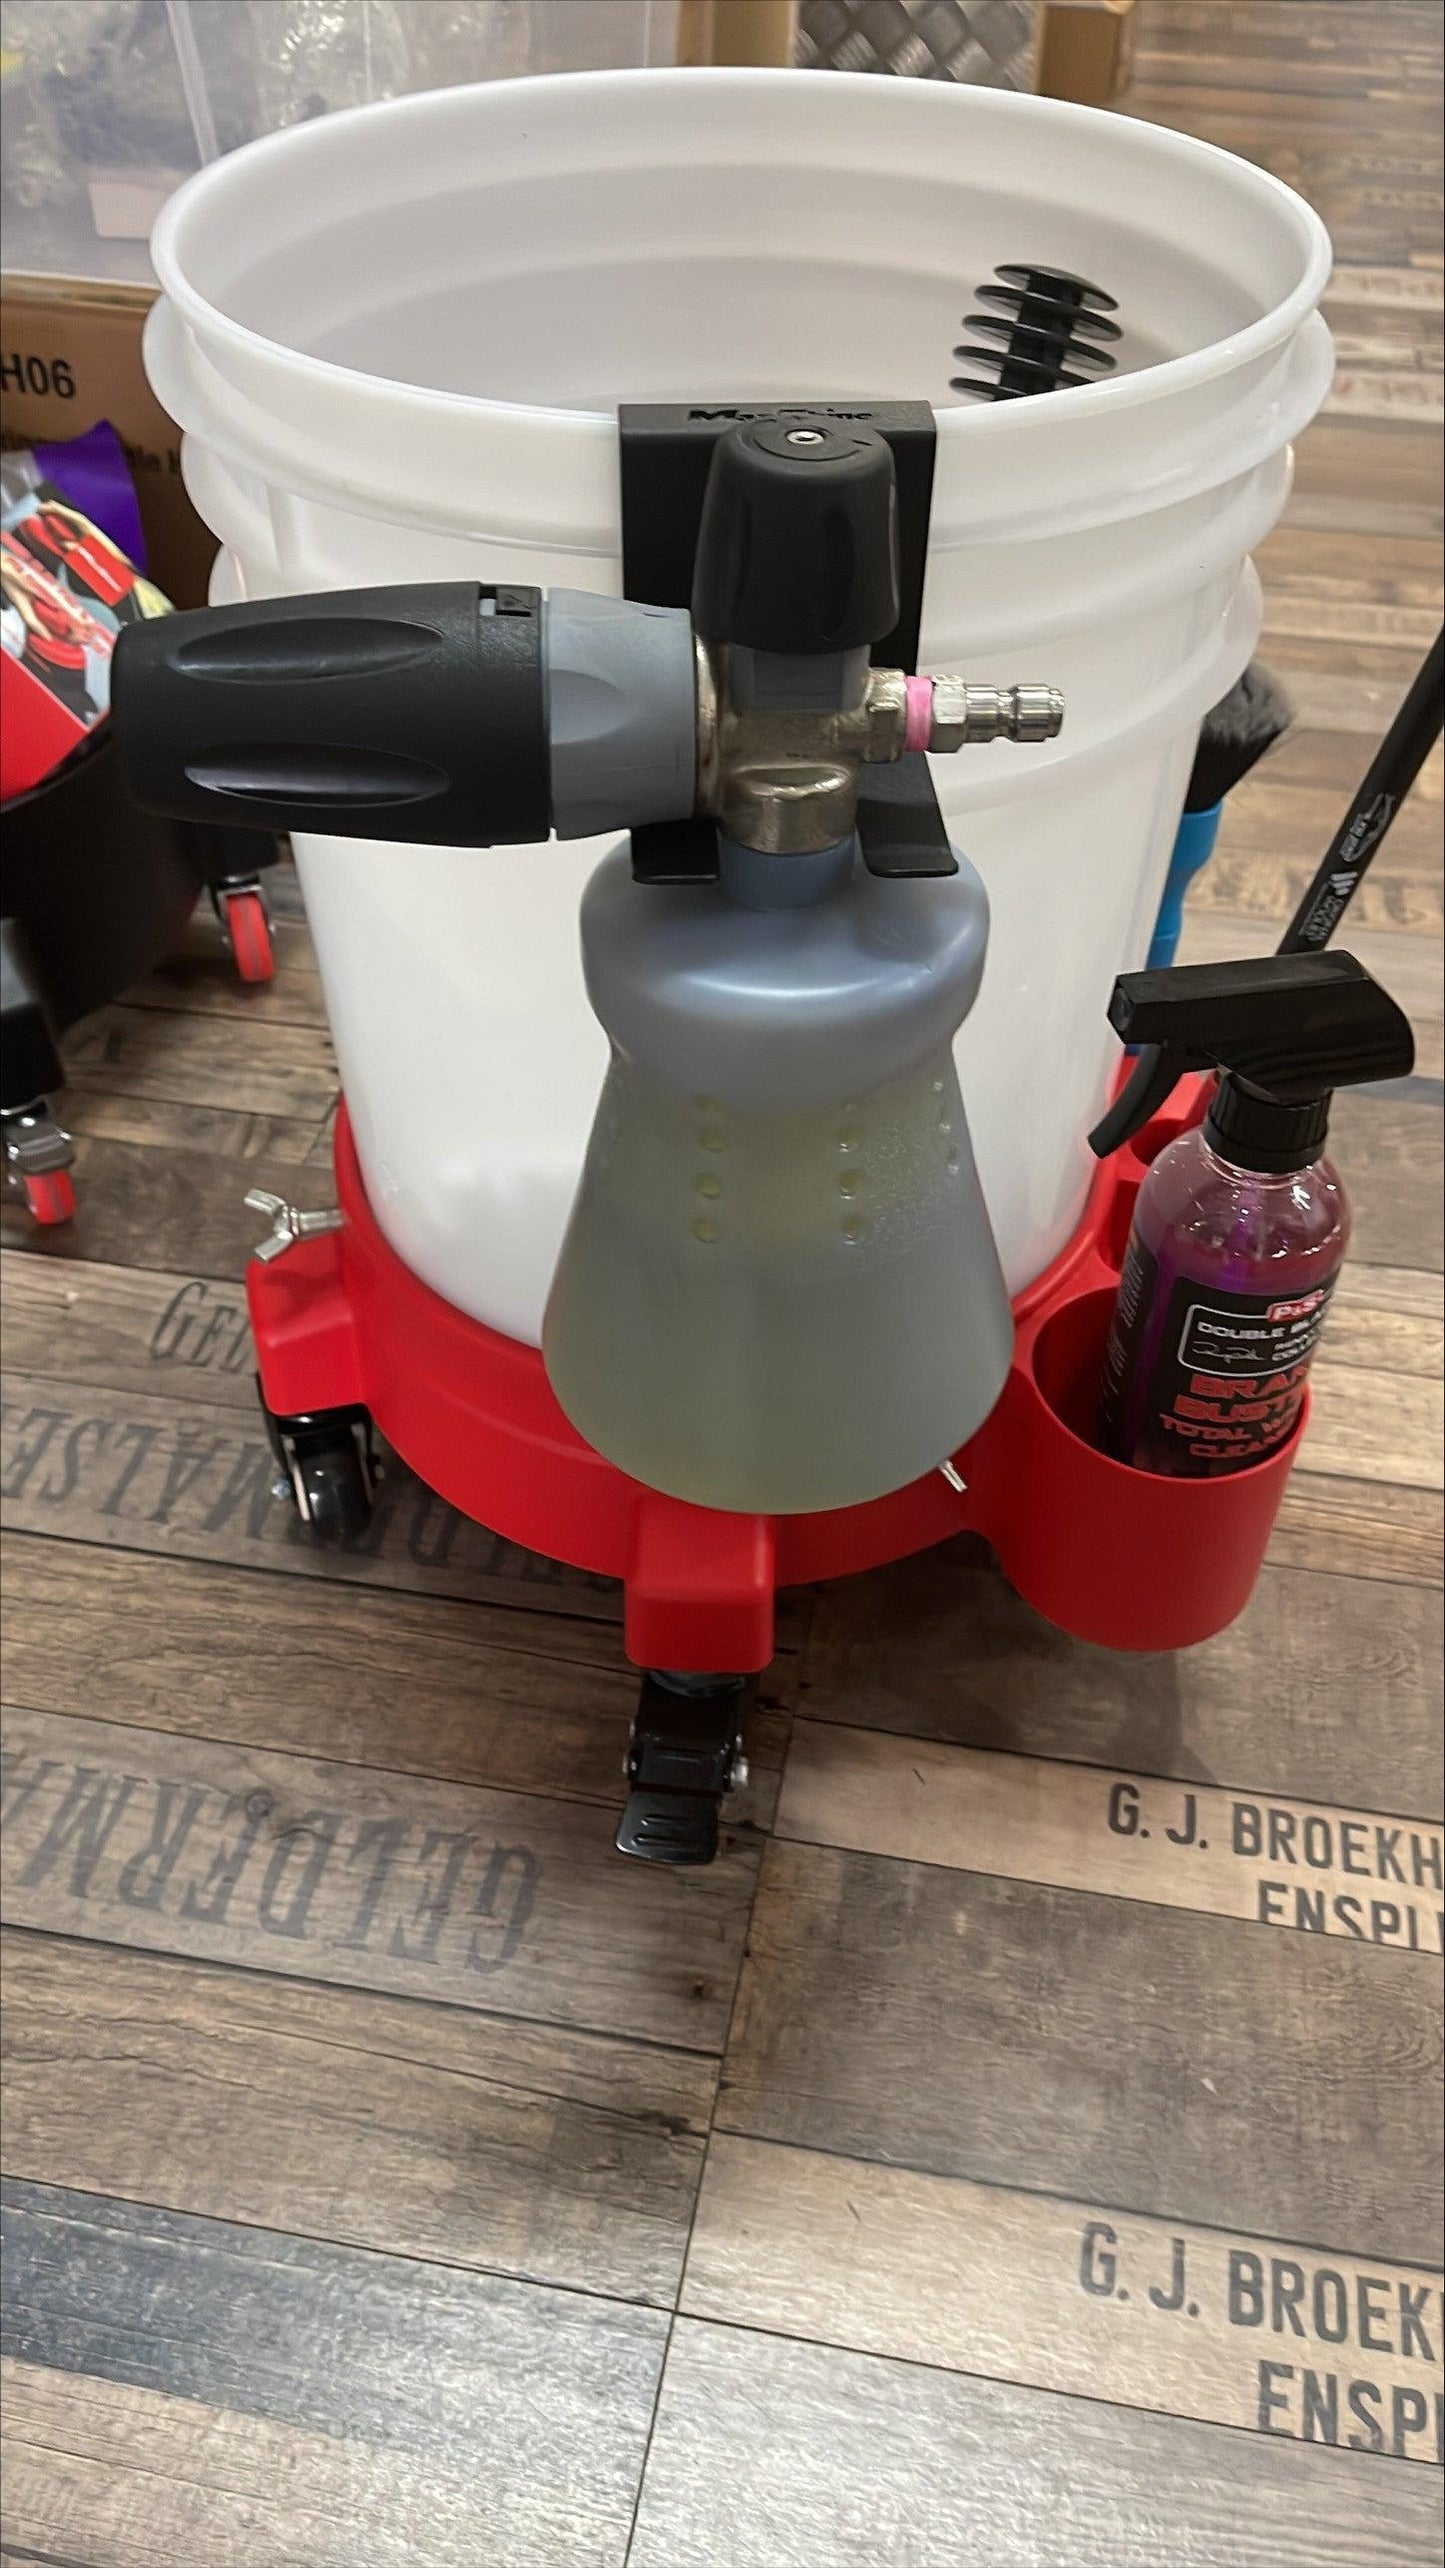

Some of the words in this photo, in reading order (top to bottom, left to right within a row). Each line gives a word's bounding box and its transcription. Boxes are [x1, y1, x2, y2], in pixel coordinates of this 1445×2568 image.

[1197, 1321, 1285, 1339] DOUBLE
[1159, 1413, 1252, 1440] TOTAL
[1107, 1783, 1149, 1839] G.
[1165, 1794, 1208, 1850] J.
[1259, 1880, 1444, 1950] ENSPI
[1080, 2221, 1131, 2302] G.
[1149, 2237, 1200, 2318] J.
[1228, 2250, 1444, 2362] BROEK
